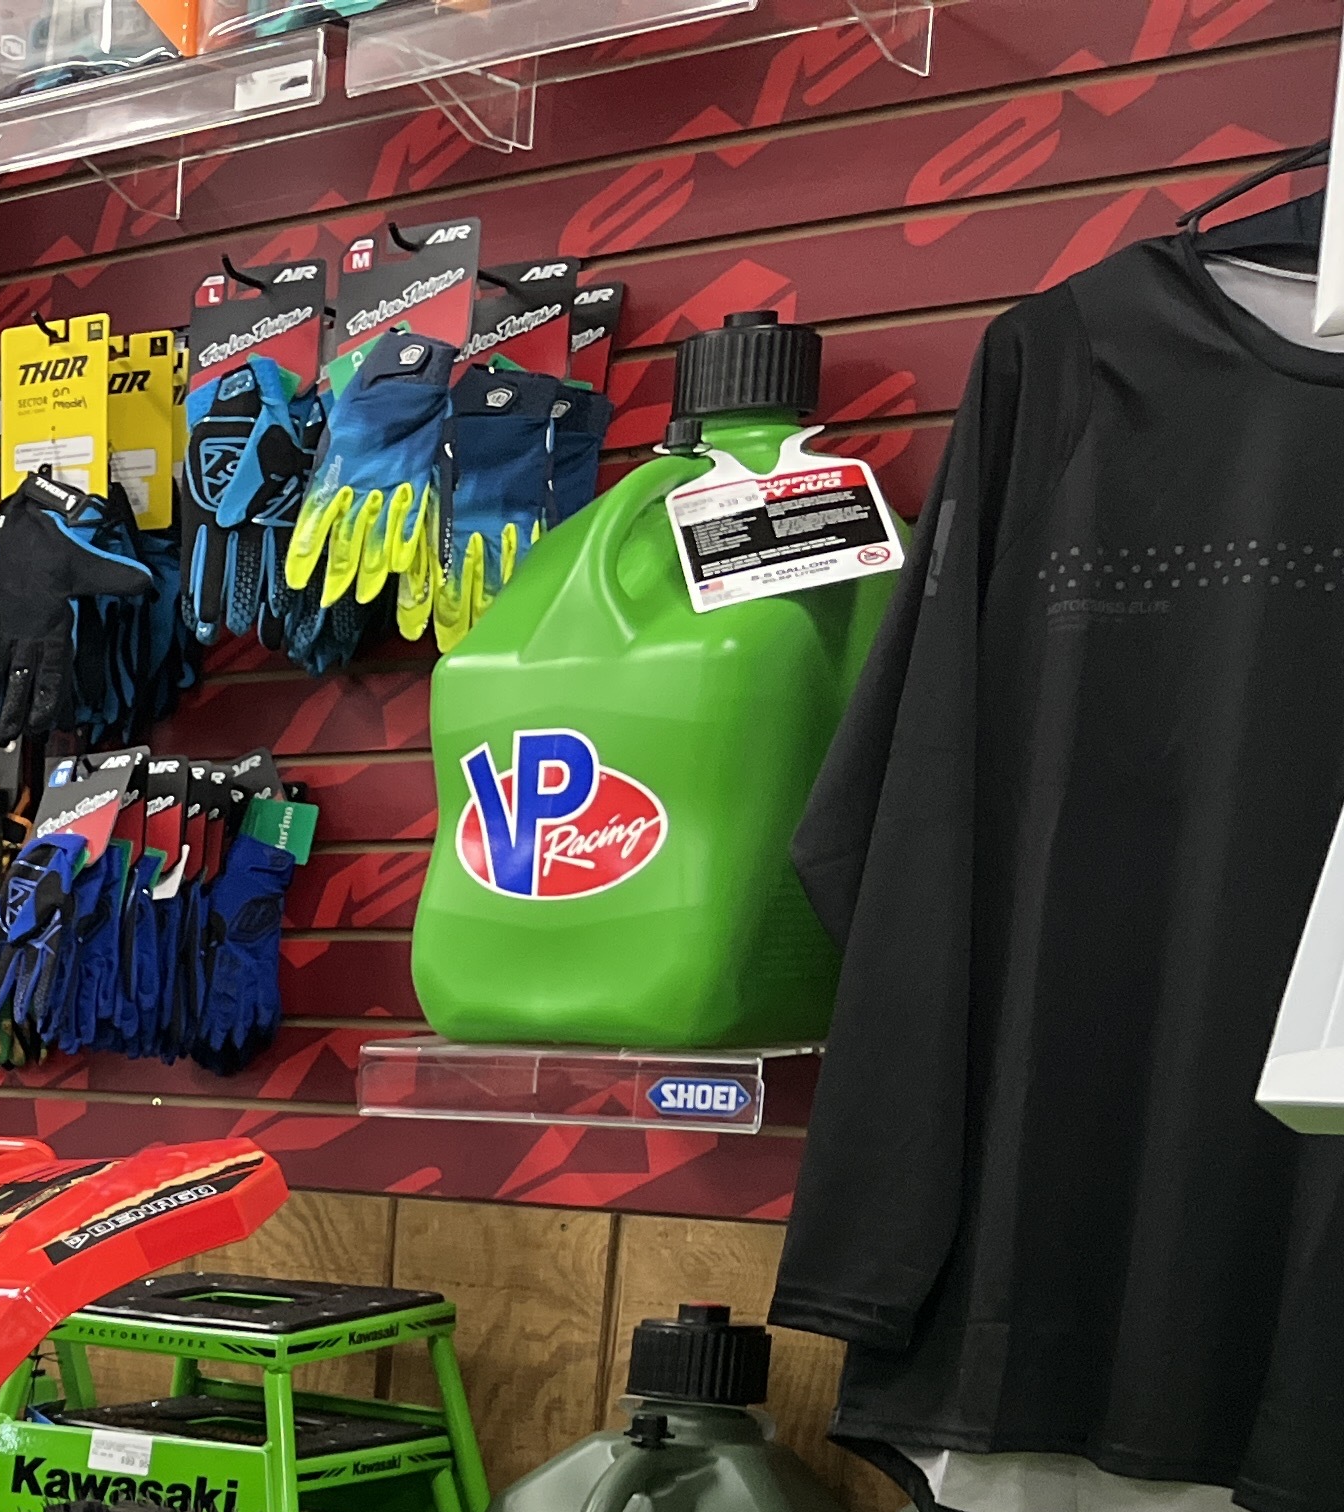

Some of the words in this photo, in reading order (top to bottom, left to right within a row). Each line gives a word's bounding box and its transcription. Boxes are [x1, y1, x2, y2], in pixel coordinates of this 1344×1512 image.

[425, 224, 472, 245] AIR
[351, 251, 370, 270] M
[272, 264, 319, 285] AIR
[519, 263, 569, 283] AIR
[208, 288, 220, 303] L
[345, 310, 378, 337] Troy
[375, 296, 404, 323] Lee
[400, 266, 467, 307] Designs
[227, 330, 257, 359] Lee
[17, 355, 89, 387] THOR
[109, 370, 152, 396] OR
[17, 394, 49, 409] SECTOR
[792, 477, 843, 495] JUG
[775, 557, 839, 577] GALLONS
[461, 727, 601, 897] VP
[543, 811, 665, 875] Racing
[660, 1082, 742, 1111] SHOEI
[86, 1184, 218, 1238] DENAGO
[78, 1325, 151, 1346] FACTORY
[157, 1334, 208, 1351] EFFEX
[347, 1321, 401, 1347] Kawasaki
[351, 1454, 403, 1477] Kawasaki
